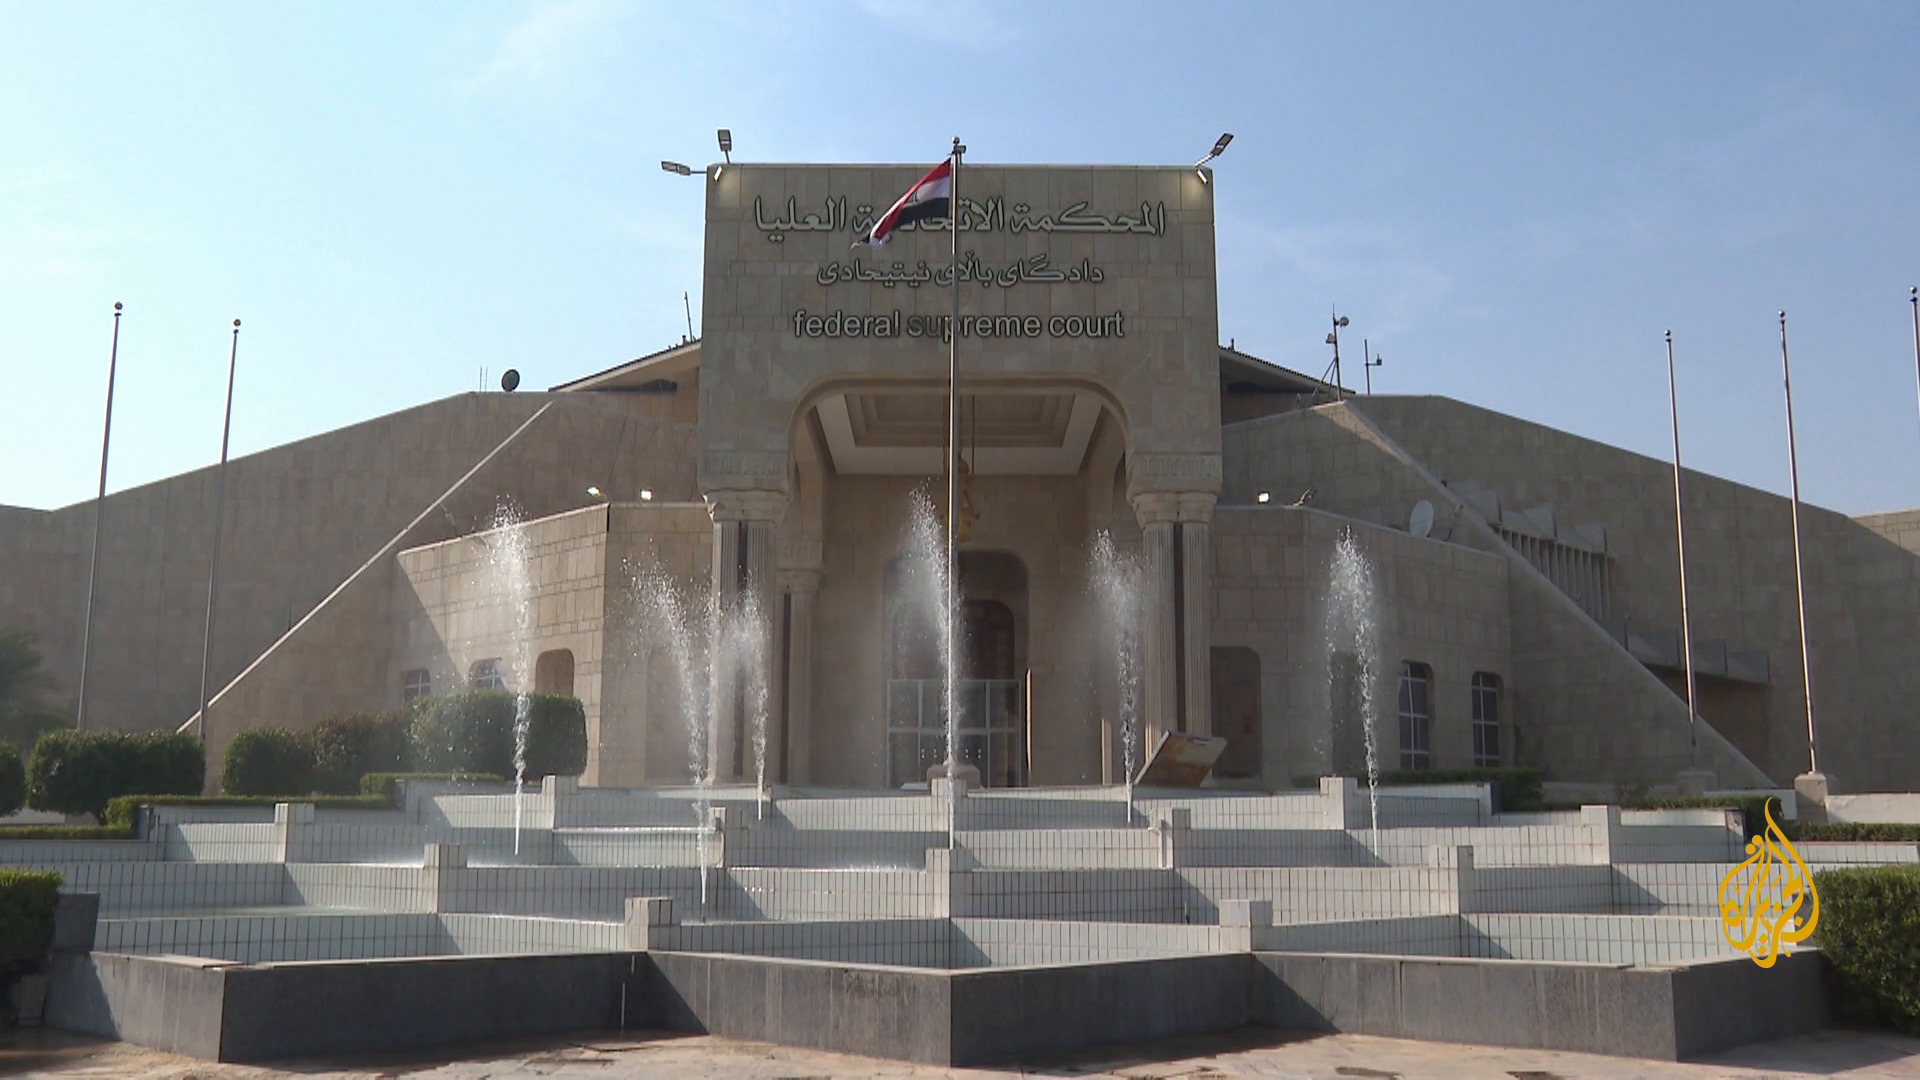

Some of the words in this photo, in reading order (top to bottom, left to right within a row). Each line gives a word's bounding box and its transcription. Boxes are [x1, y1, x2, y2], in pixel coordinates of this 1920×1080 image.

[754, 195, 846, 243] العليا
[1010, 201, 1166, 237] المحكمة
[793, 310, 900, 337] federal
[906, 315, 1041, 343] supreme
[1049, 311, 1125, 337] court
